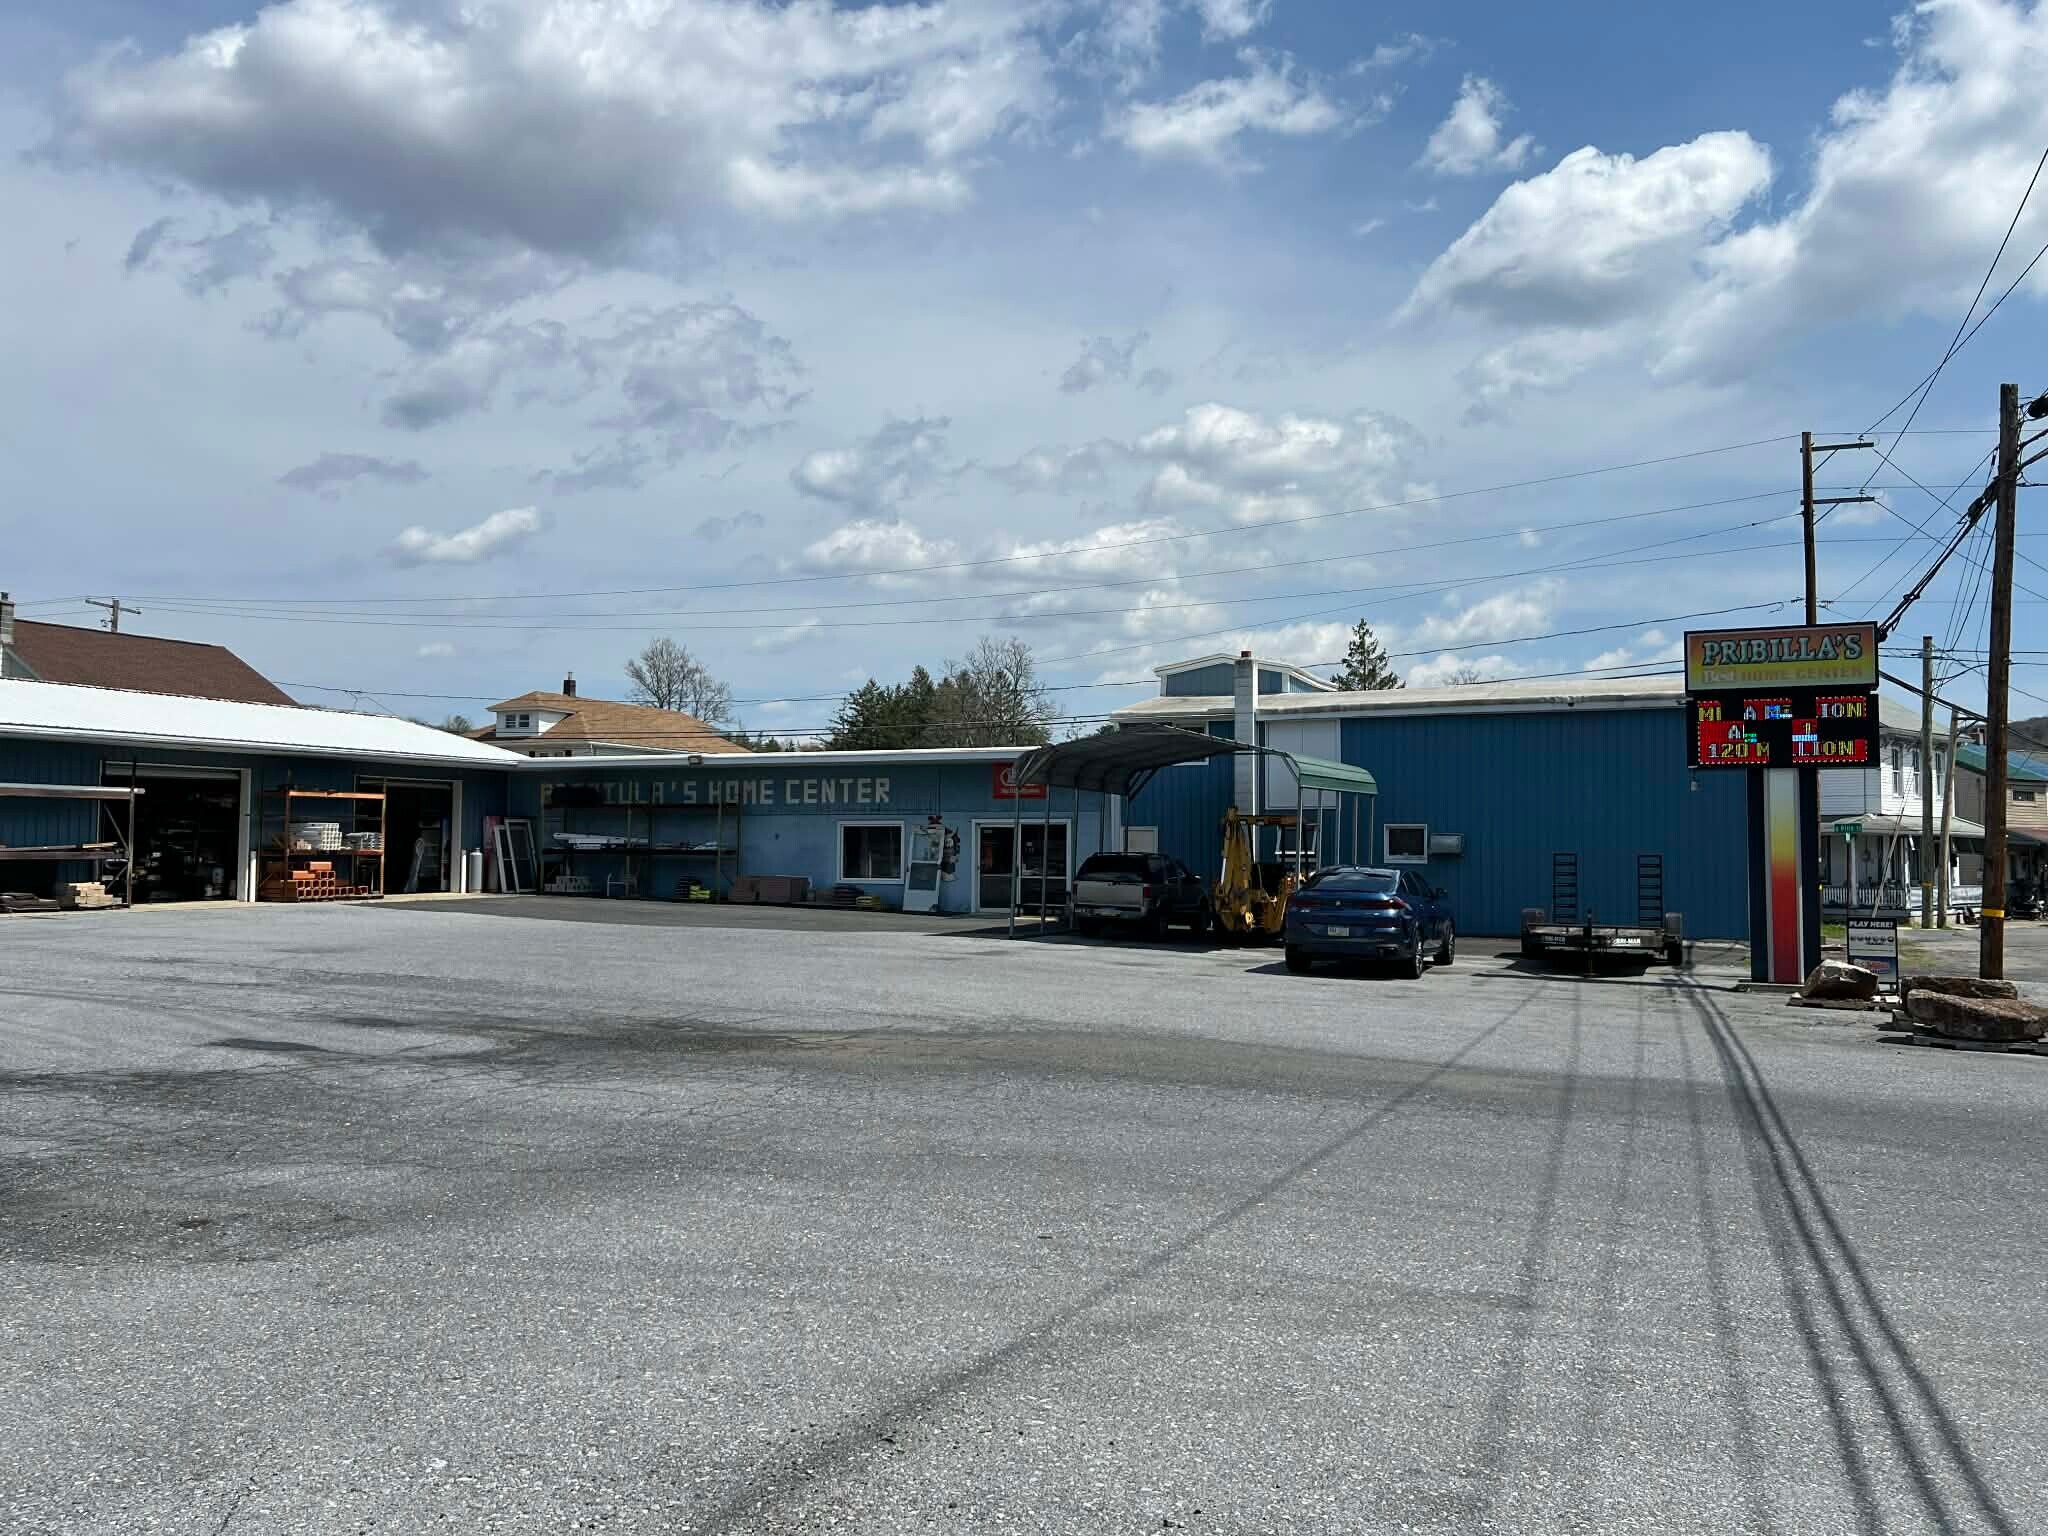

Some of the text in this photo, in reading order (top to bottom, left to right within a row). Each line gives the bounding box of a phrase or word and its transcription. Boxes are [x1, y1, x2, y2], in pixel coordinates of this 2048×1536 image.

[1702, 633, 1863, 666] PRIBILLA'S
[1707, 742, 1750, 758] 120
[708, 779, 774, 805] HOME
[784, 777, 891, 805] CENTER
[1849, 920, 1894, 929] PLAY HERE!
